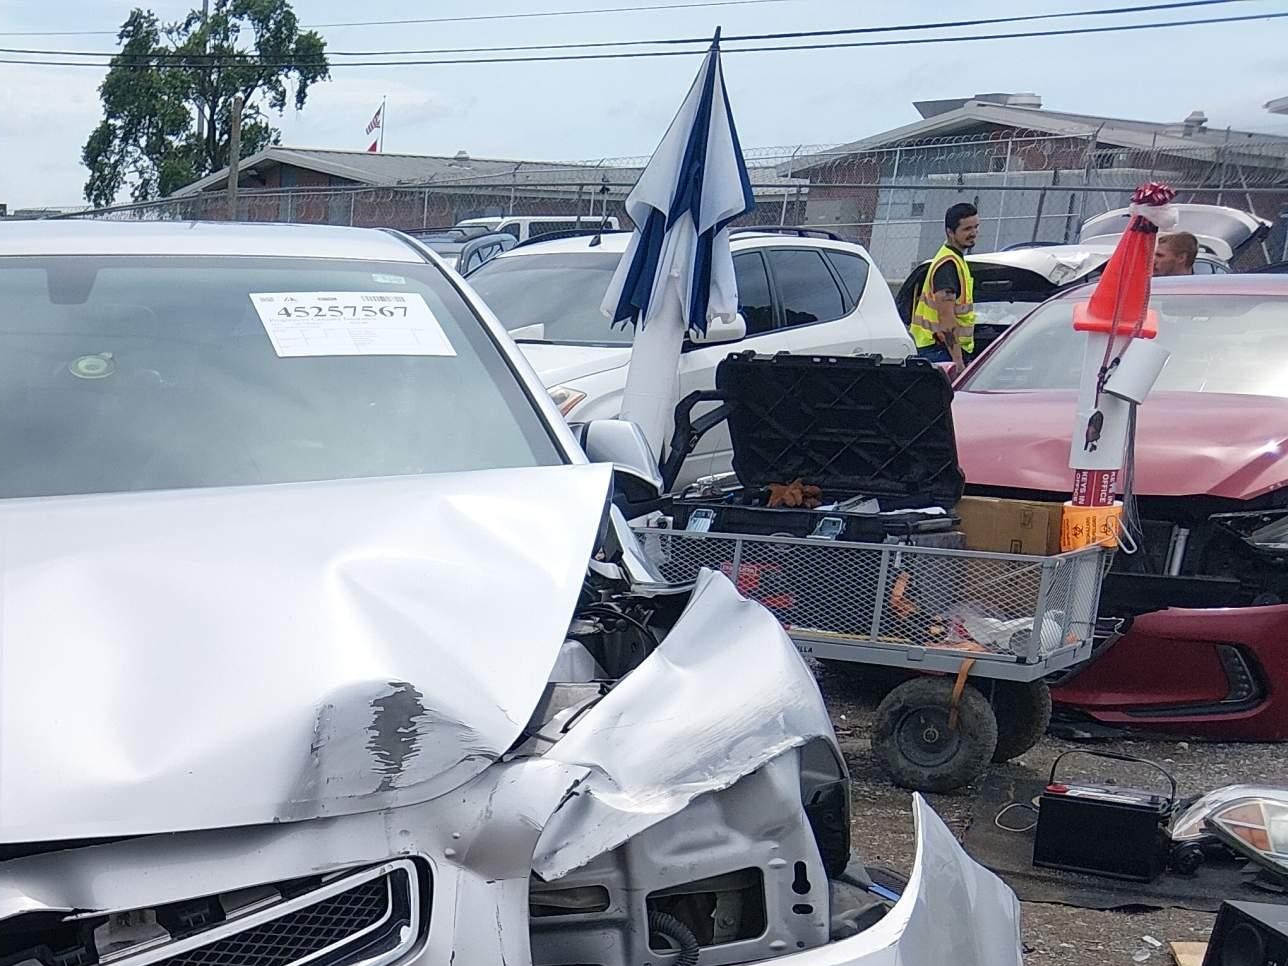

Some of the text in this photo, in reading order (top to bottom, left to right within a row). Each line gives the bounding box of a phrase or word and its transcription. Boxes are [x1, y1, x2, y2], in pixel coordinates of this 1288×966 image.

[277, 305, 408, 318] 45257567
[1078, 471, 1088, 505] KEYS IN
[1099, 473, 1109, 503] OFFICE
